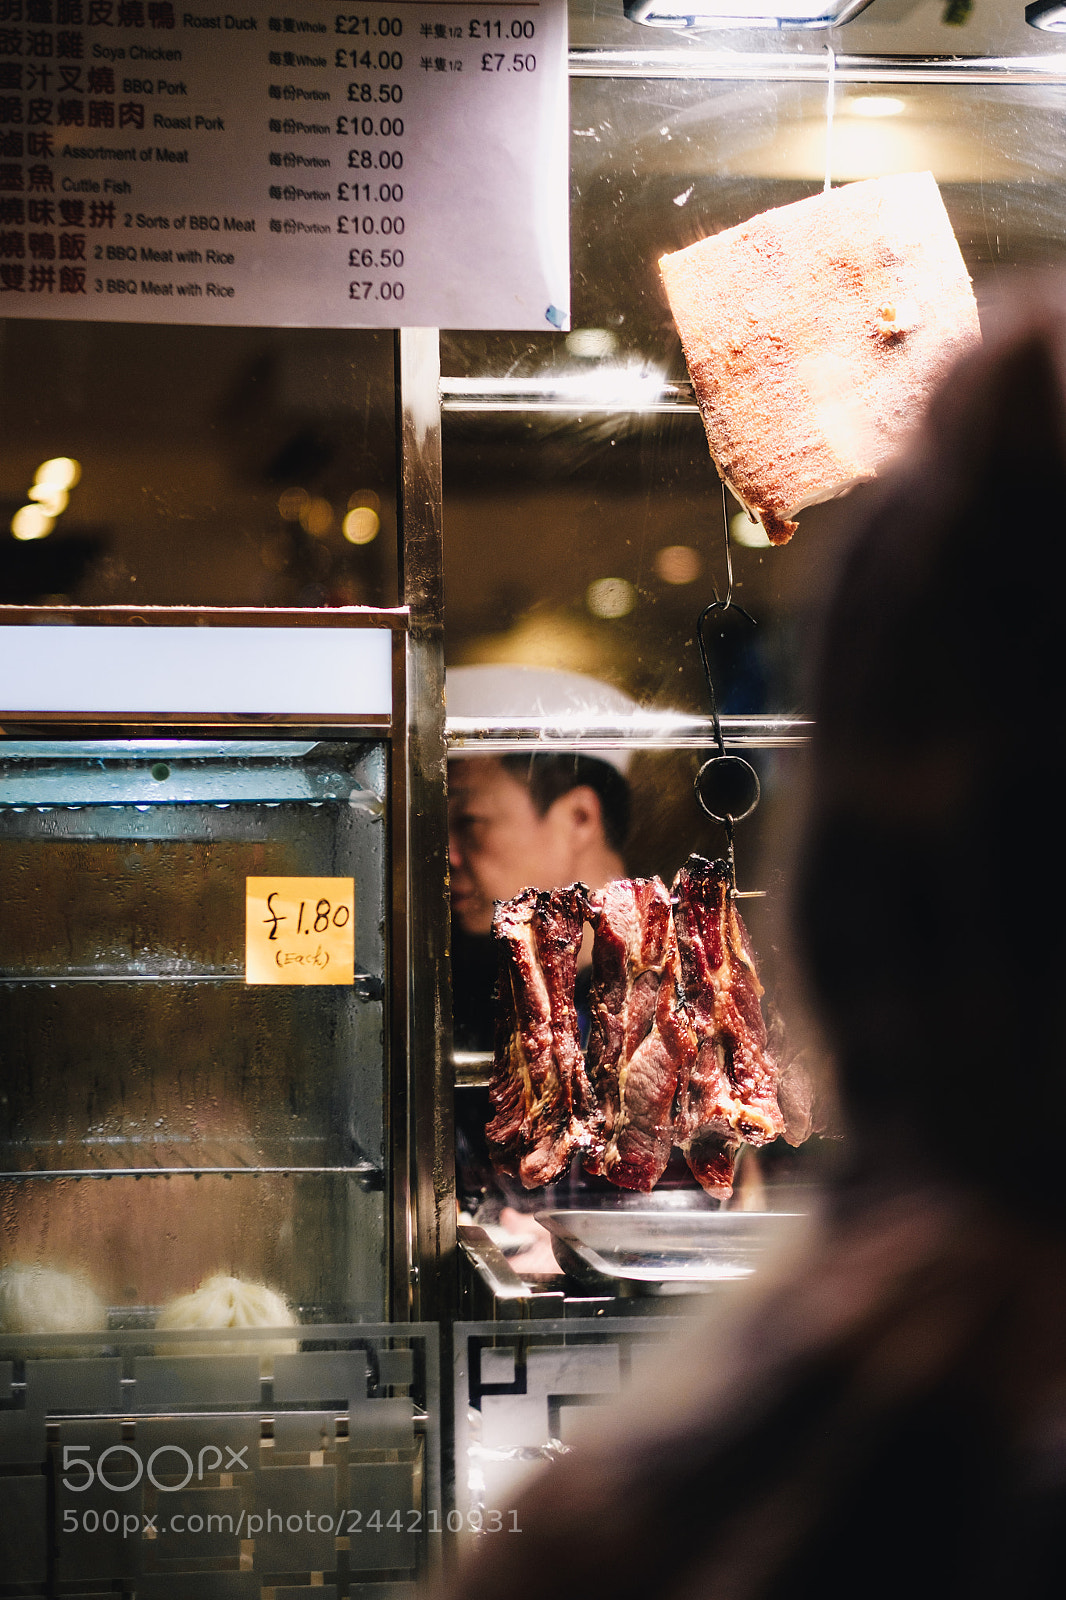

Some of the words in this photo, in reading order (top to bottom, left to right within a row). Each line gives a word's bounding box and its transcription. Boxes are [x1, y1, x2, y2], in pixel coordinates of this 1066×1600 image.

[183, 14, 221, 29] Roast
[225, 16, 257, 31] Duck
[335, 15, 402, 37] £21.00
[468, 19, 534, 39] £11.00
[92, 44, 125, 62] Soya
[130, 46, 182, 61] Chicken
[335, 48, 402, 70] £14.00
[481, 53, 537, 73] £7.50
[123, 79, 154, 95] BBQ
[159, 80, 187, 95] Pork
[347, 83, 402, 104] £8.50
[154, 114, 191, 130] Roast
[196, 116, 225, 131] Pork
[336, 116, 404, 137] £10.00
[63, 145, 136, 162] Assortment
[140, 147, 153, 162] of
[156, 149, 188, 163] Meat
[347, 149, 403, 170] £8.00
[0, 164, 55, 193] 墨魚
[62, 178, 100, 193] Cuttle
[104, 179, 131, 194] Fish
[337, 182, 403, 202] £11.00
[0, 197, 116, 229] 燒味雙拼
[124, 213, 132, 228] 2
[136, 214, 170, 229] Sorts
[174, 215, 187, 230] of
[189, 216, 220, 232] BBQ
[224, 217, 255, 232] Meat
[337, 215, 404, 235] £10.00
[94, 246, 103, 260] 2
[106, 246, 137, 262] BBQ
[141, 248, 173, 263] Meat
[176, 249, 202, 264] with
[206, 249, 235, 265] Rice
[348, 248, 404, 268] £6.50
[95, 279, 103, 293] 3
[106, 280, 137, 295] BBQ
[141, 281, 173, 296] Meat
[176, 282, 202, 297] with
[206, 283, 235, 298] Rice
[349, 281, 404, 301] £7.00
